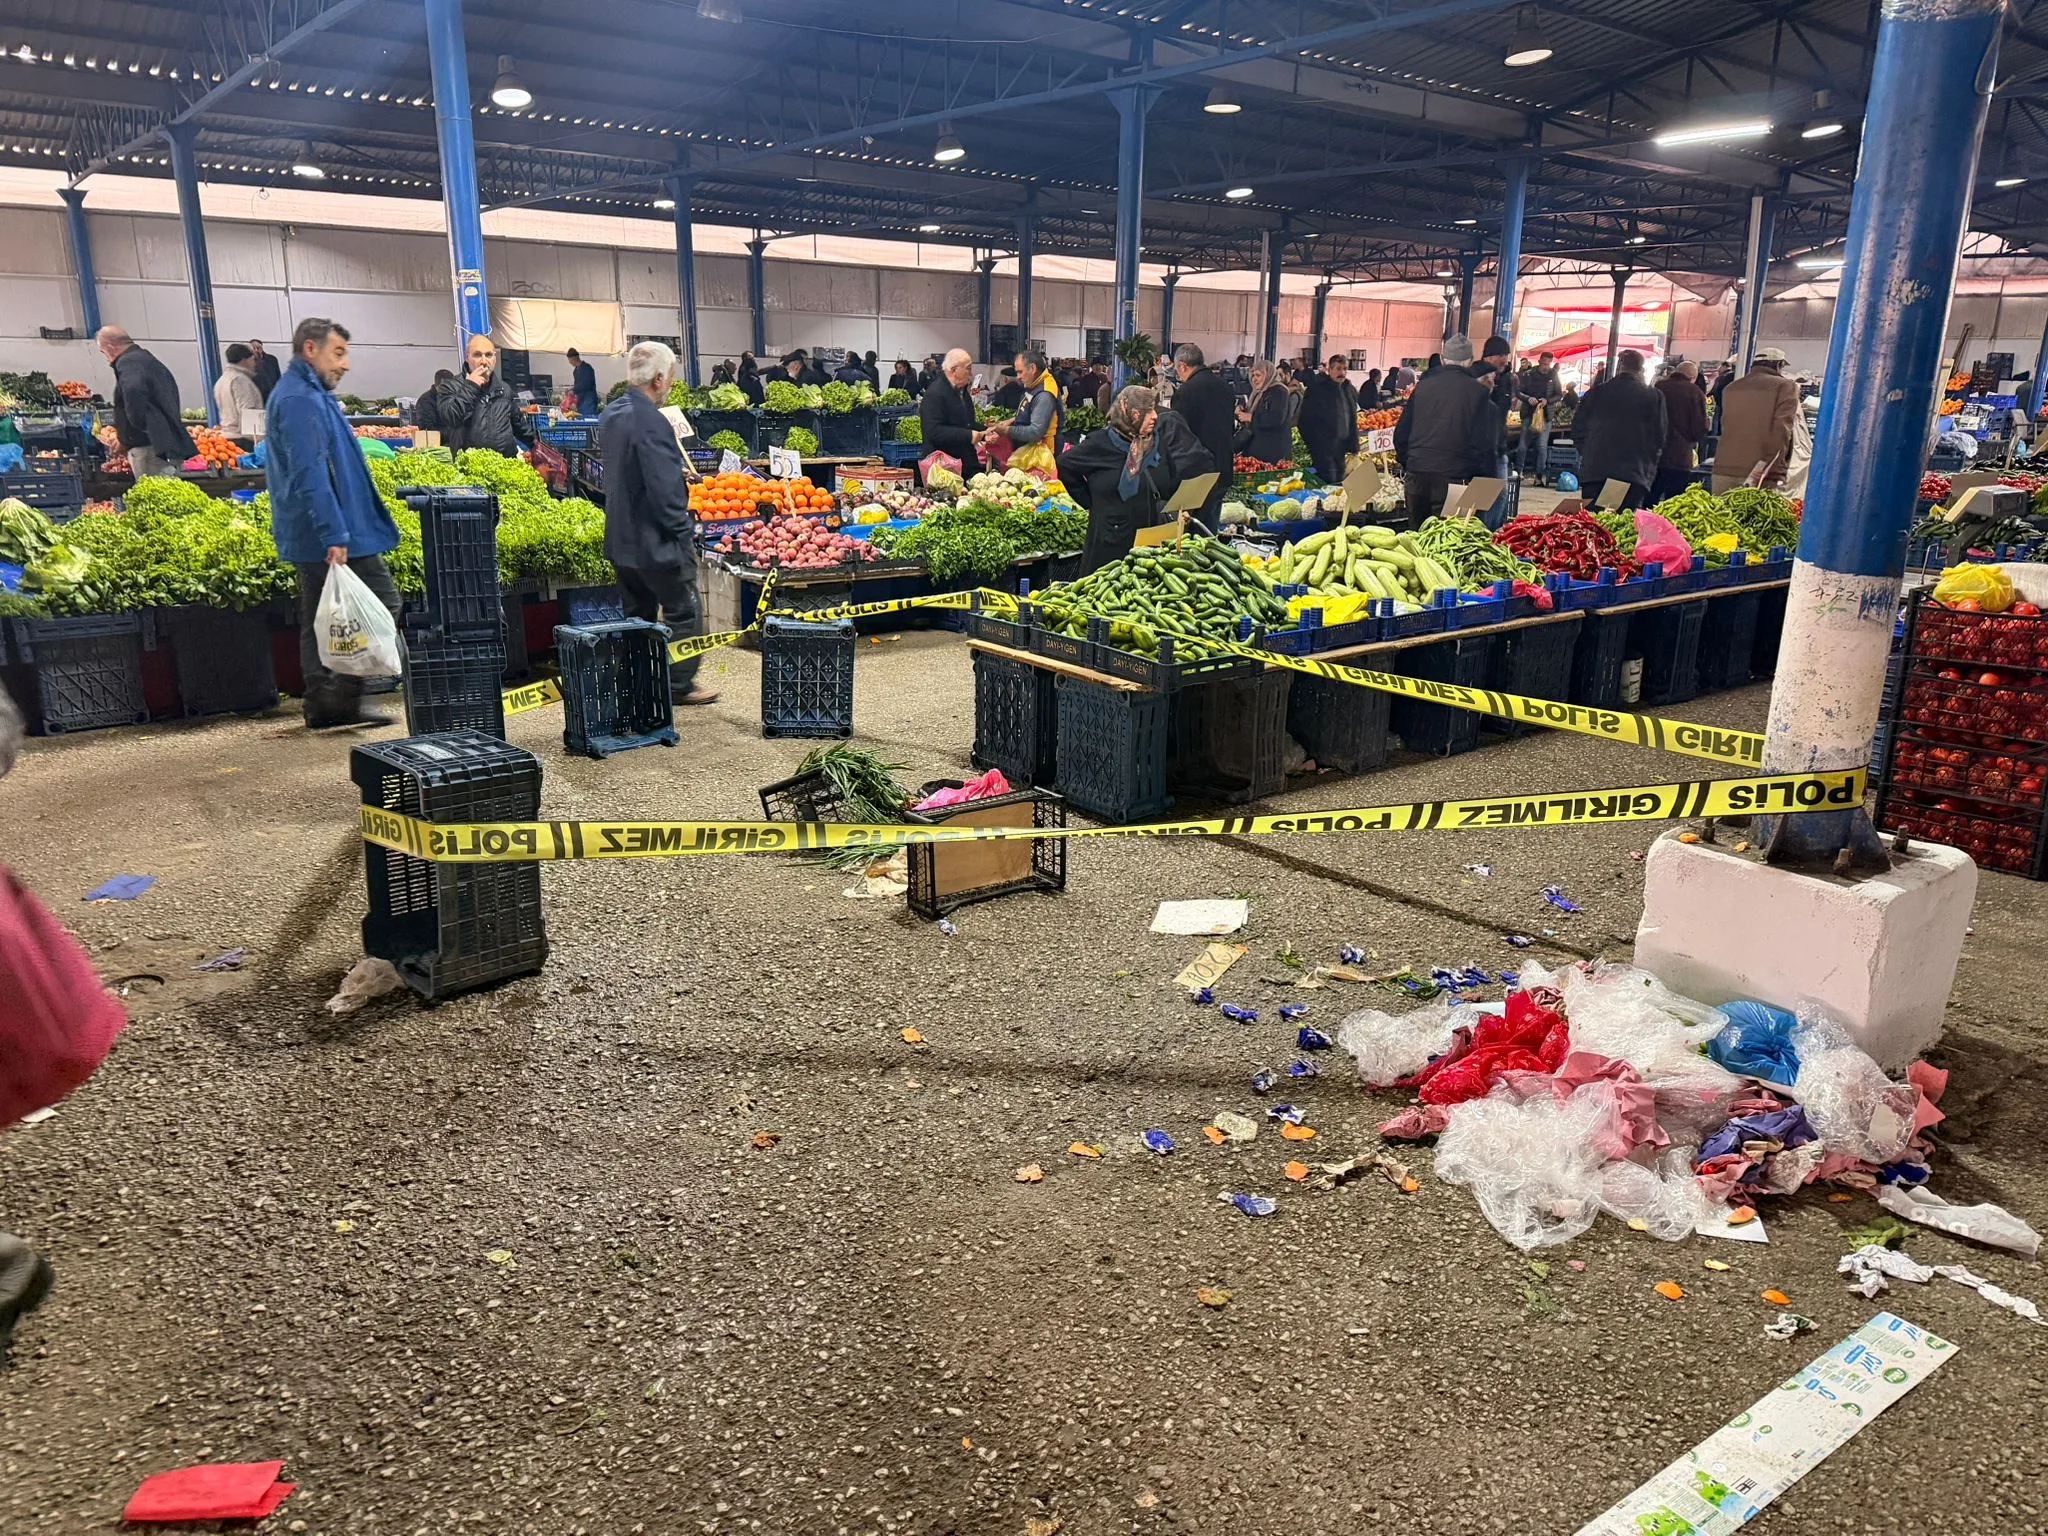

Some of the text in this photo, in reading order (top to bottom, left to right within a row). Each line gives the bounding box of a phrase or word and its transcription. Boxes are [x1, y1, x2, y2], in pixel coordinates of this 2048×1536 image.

[1458, 792, 1662, 827] GİRİLMEZ
[1728, 775, 1854, 810] POLİS
[1269, 810, 1393, 834] POLİS
